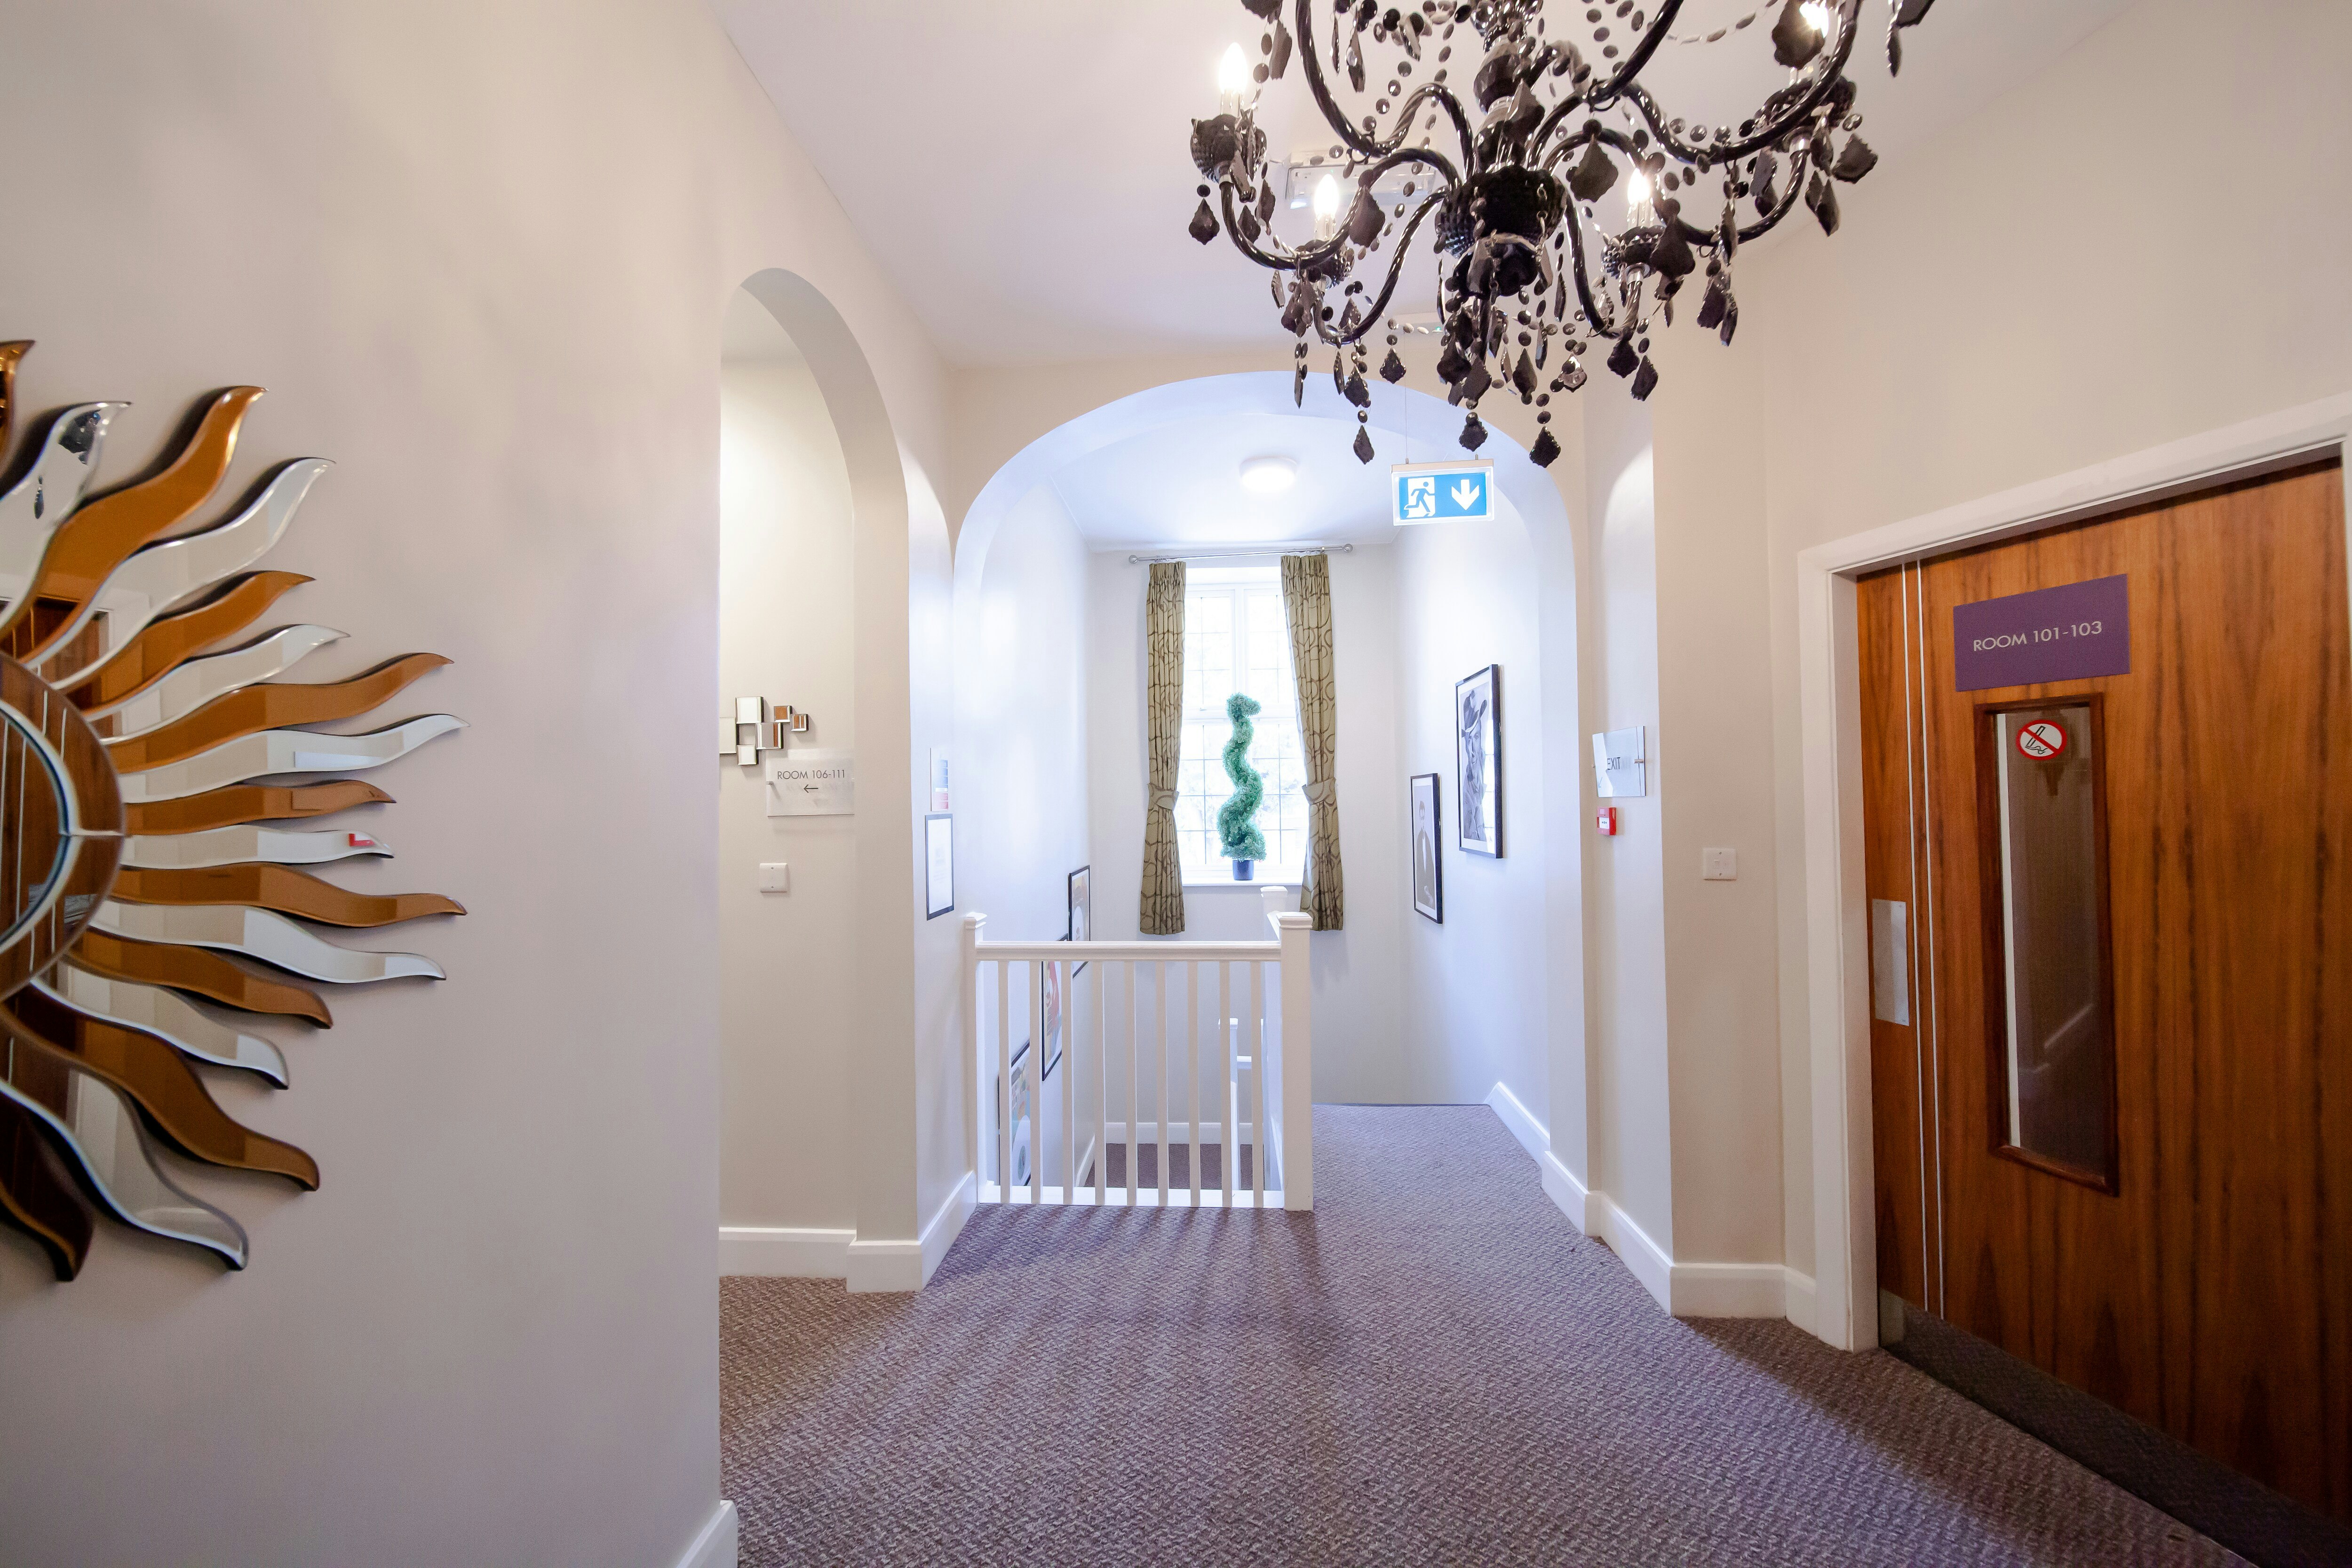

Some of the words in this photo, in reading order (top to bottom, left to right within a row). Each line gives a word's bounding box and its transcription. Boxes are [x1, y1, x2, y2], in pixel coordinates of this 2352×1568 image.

[1973, 633, 2027, 651] ROOM
[2034, 621, 2102, 643] 101-103
[1607, 757, 1621, 770] EXIT
[777, 771, 808, 780] ROOM
[812, 769, 845, 779] 106-111
